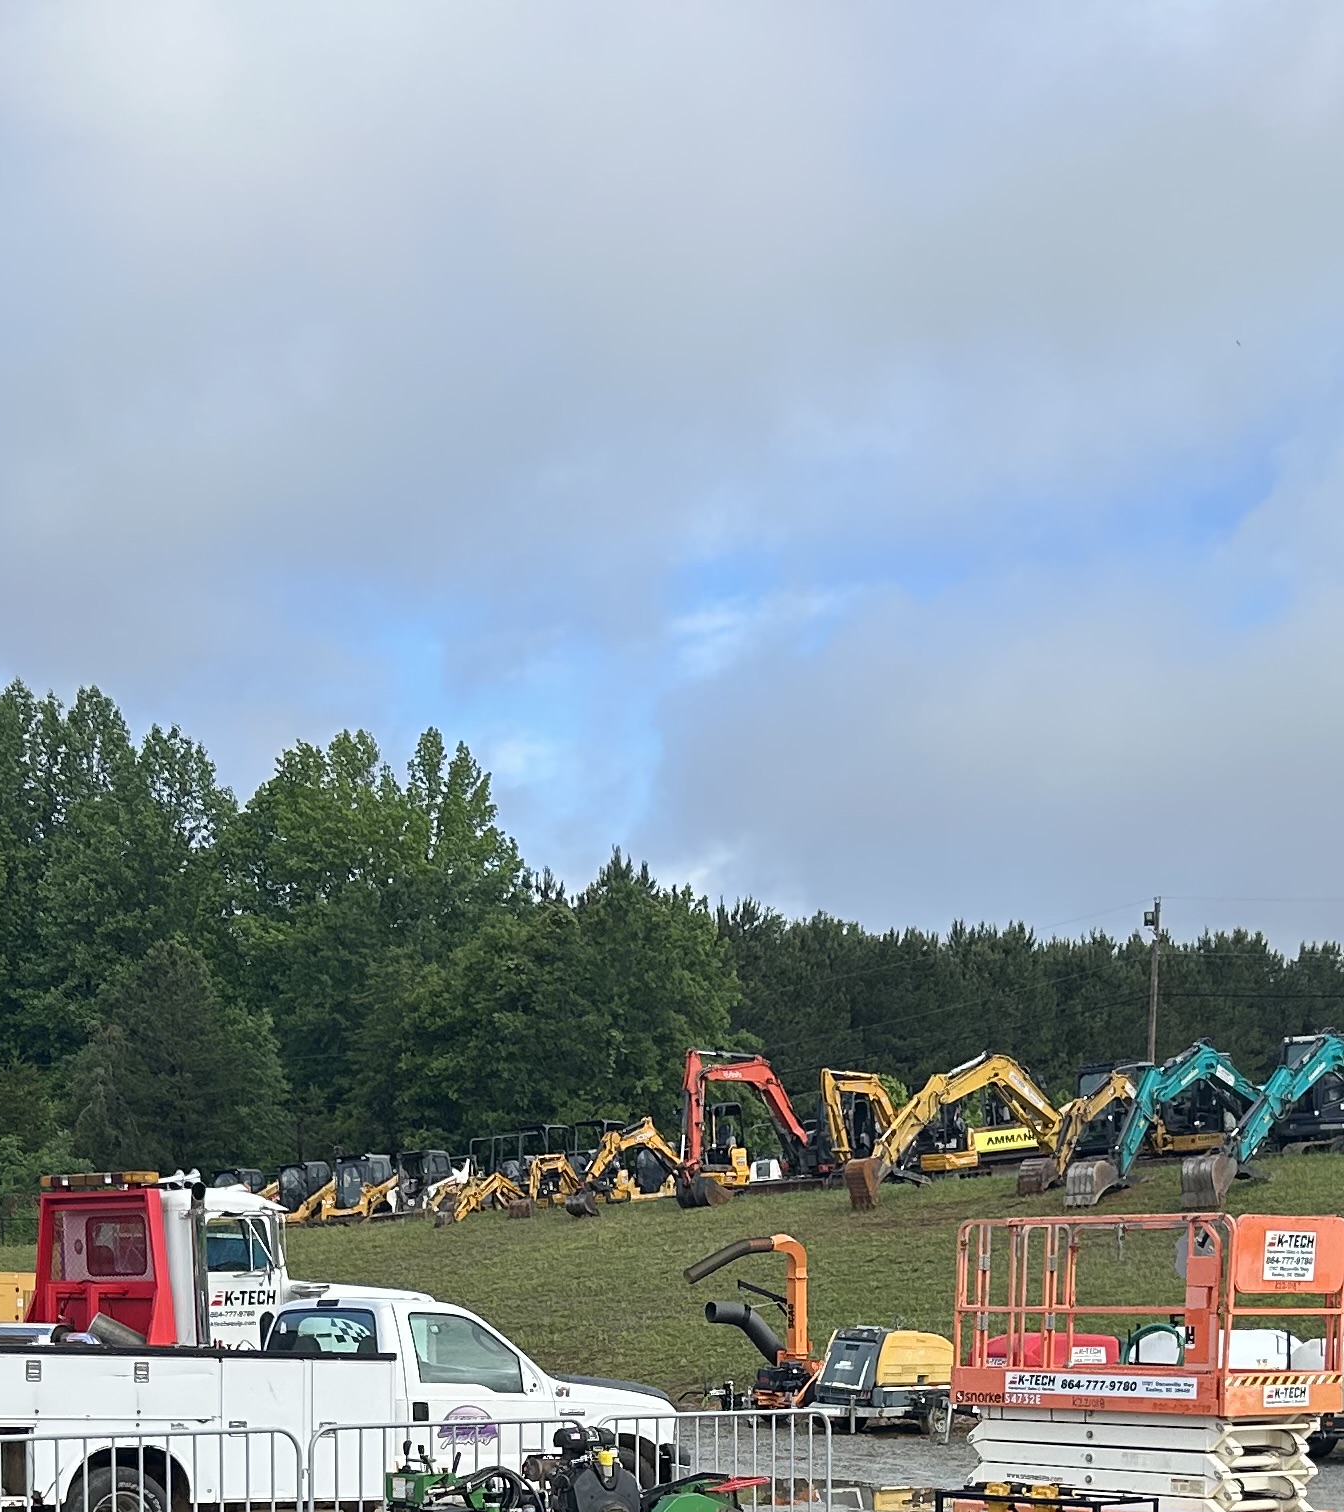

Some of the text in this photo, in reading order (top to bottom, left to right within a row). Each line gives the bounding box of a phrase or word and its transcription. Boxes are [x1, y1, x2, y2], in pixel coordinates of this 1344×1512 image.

[1277, 1234, 1315, 1248] K-TECH
[224, 1290, 276, 1306] K-TECH
[1018, 1374, 1056, 1386] K-TECH
[1060, 1378, 1137, 1391] 864-777-9780
[1275, 1386, 1306, 1398] K-TECH
